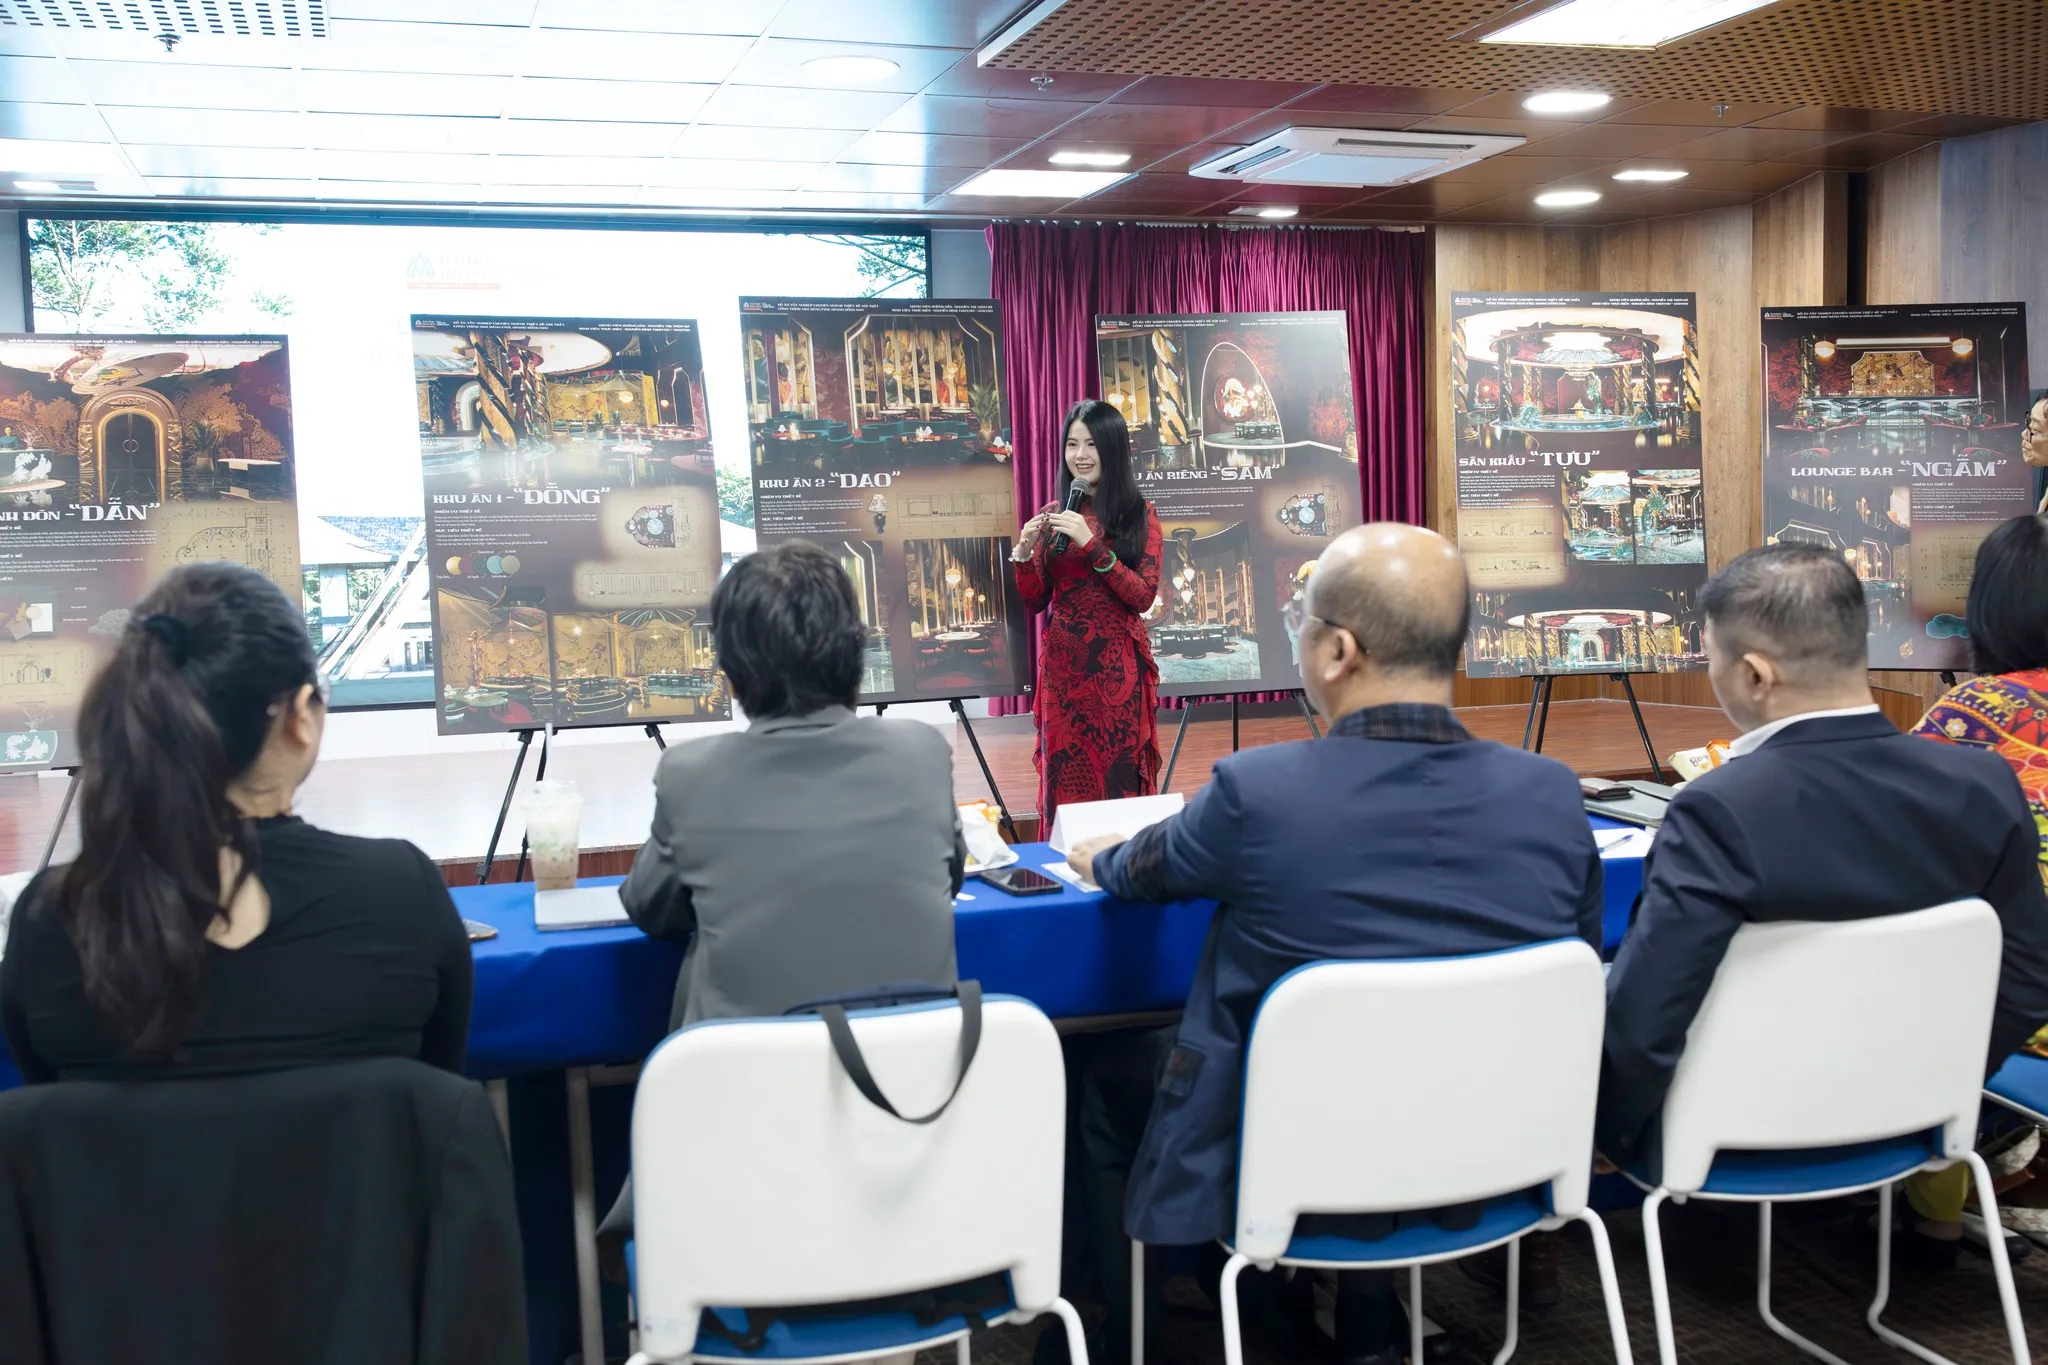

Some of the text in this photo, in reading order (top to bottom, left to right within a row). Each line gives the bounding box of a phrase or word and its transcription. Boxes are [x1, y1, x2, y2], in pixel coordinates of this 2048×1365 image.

[1791, 467, 1856, 477] LOUNGE
[1860, 467, 1893, 477] BAR
[759, 479, 789, 489] KHU
[815, 478, 825, 487] 2
[432, 494, 467, 504] KHU
[496, 494, 503, 503] 1
